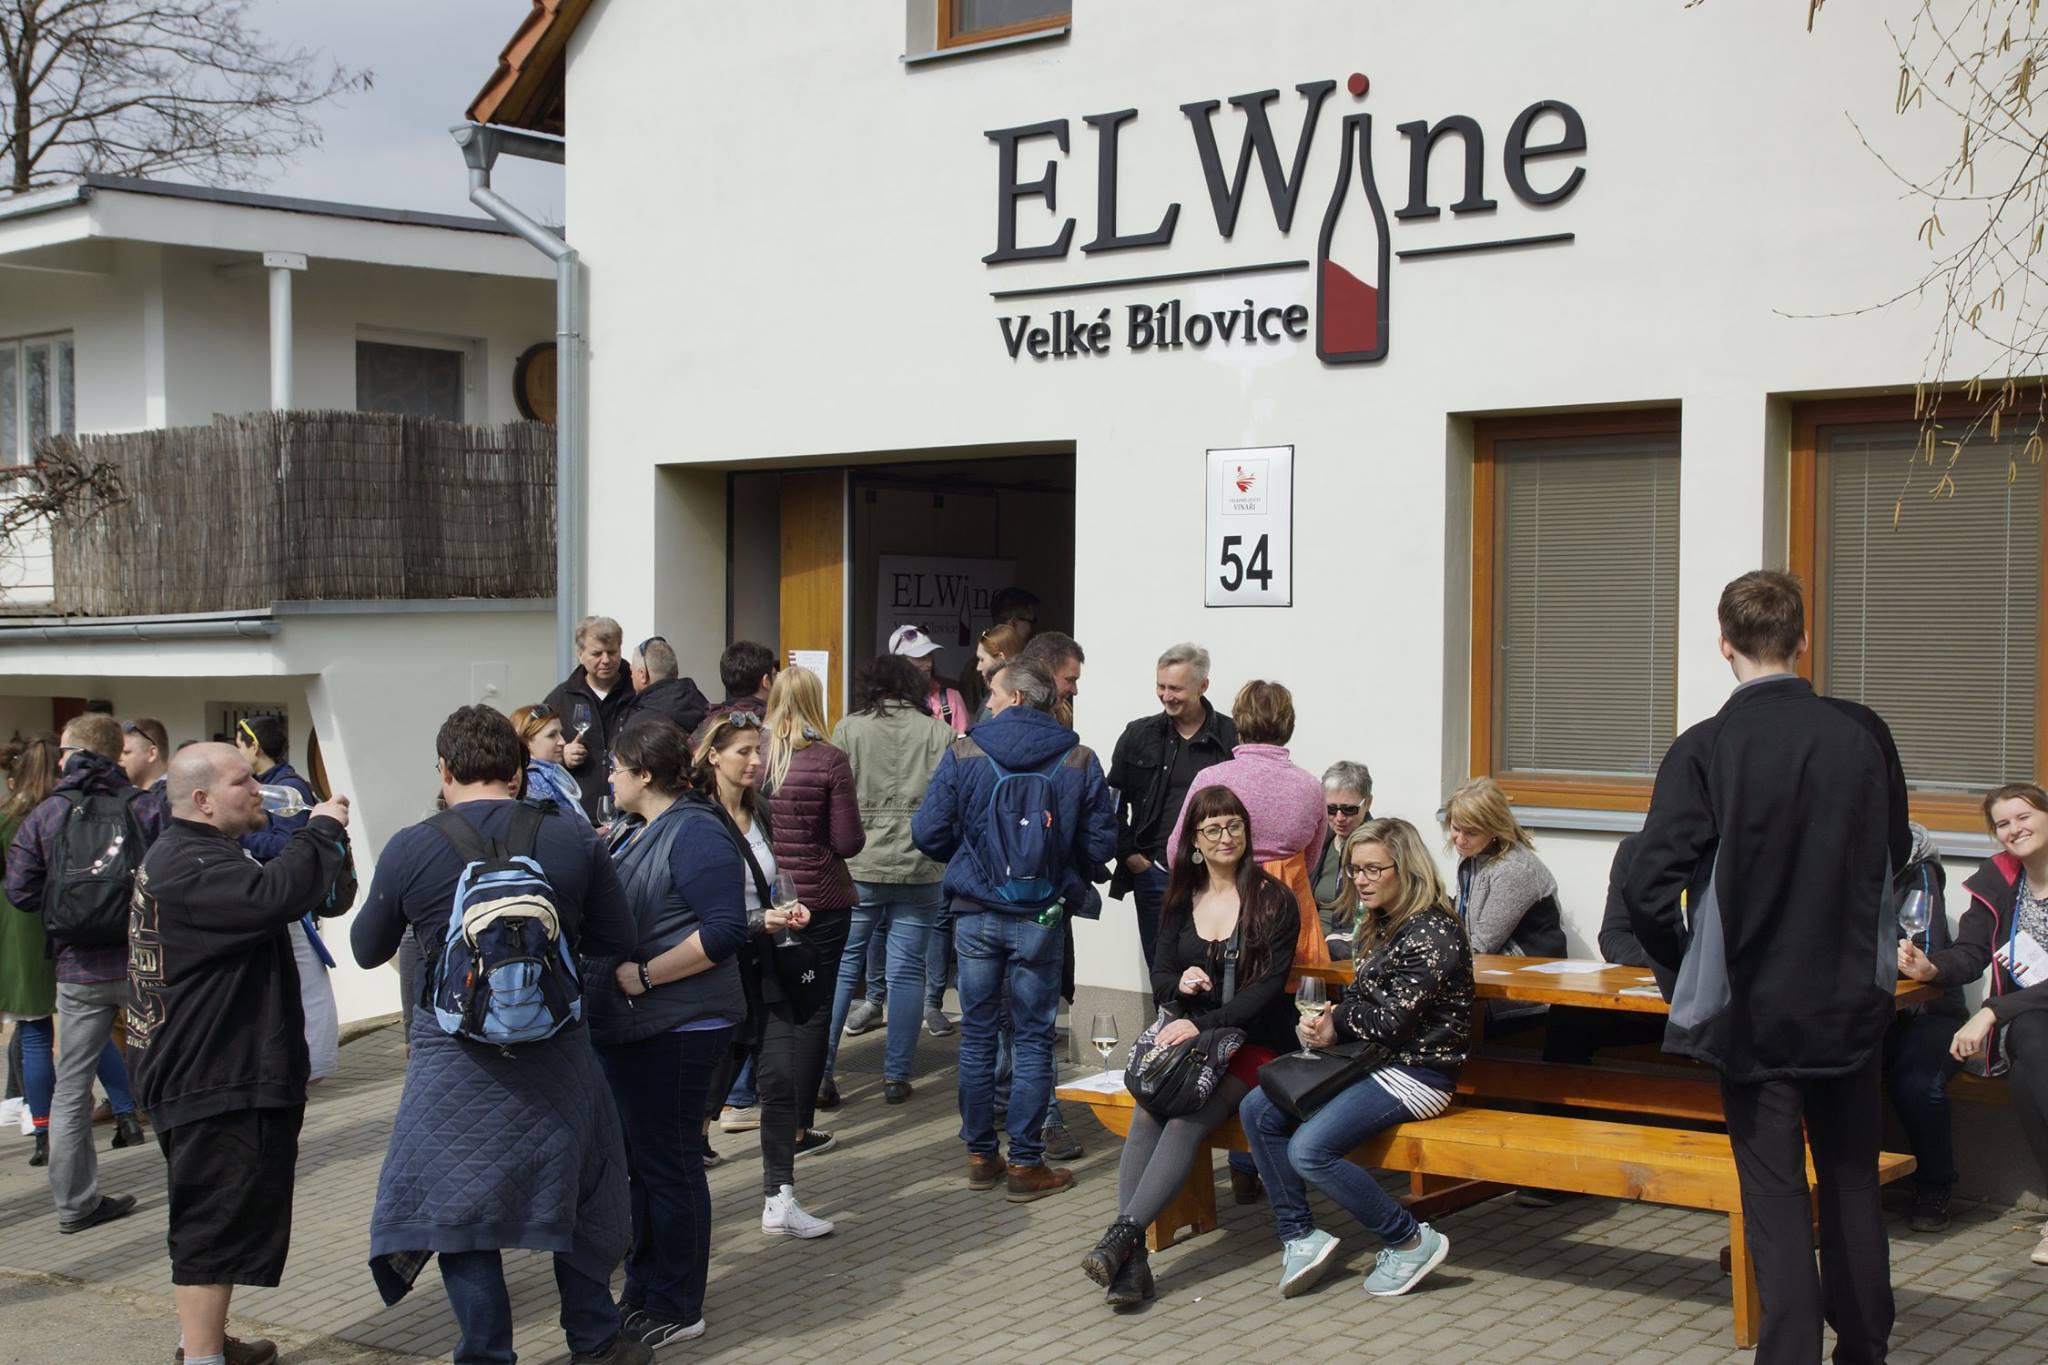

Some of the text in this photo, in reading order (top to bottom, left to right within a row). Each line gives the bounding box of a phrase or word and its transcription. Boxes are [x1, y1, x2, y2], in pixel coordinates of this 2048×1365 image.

[998, 299, 1310, 359] Velké Bílovice
[1220, 533, 1273, 592] 54
